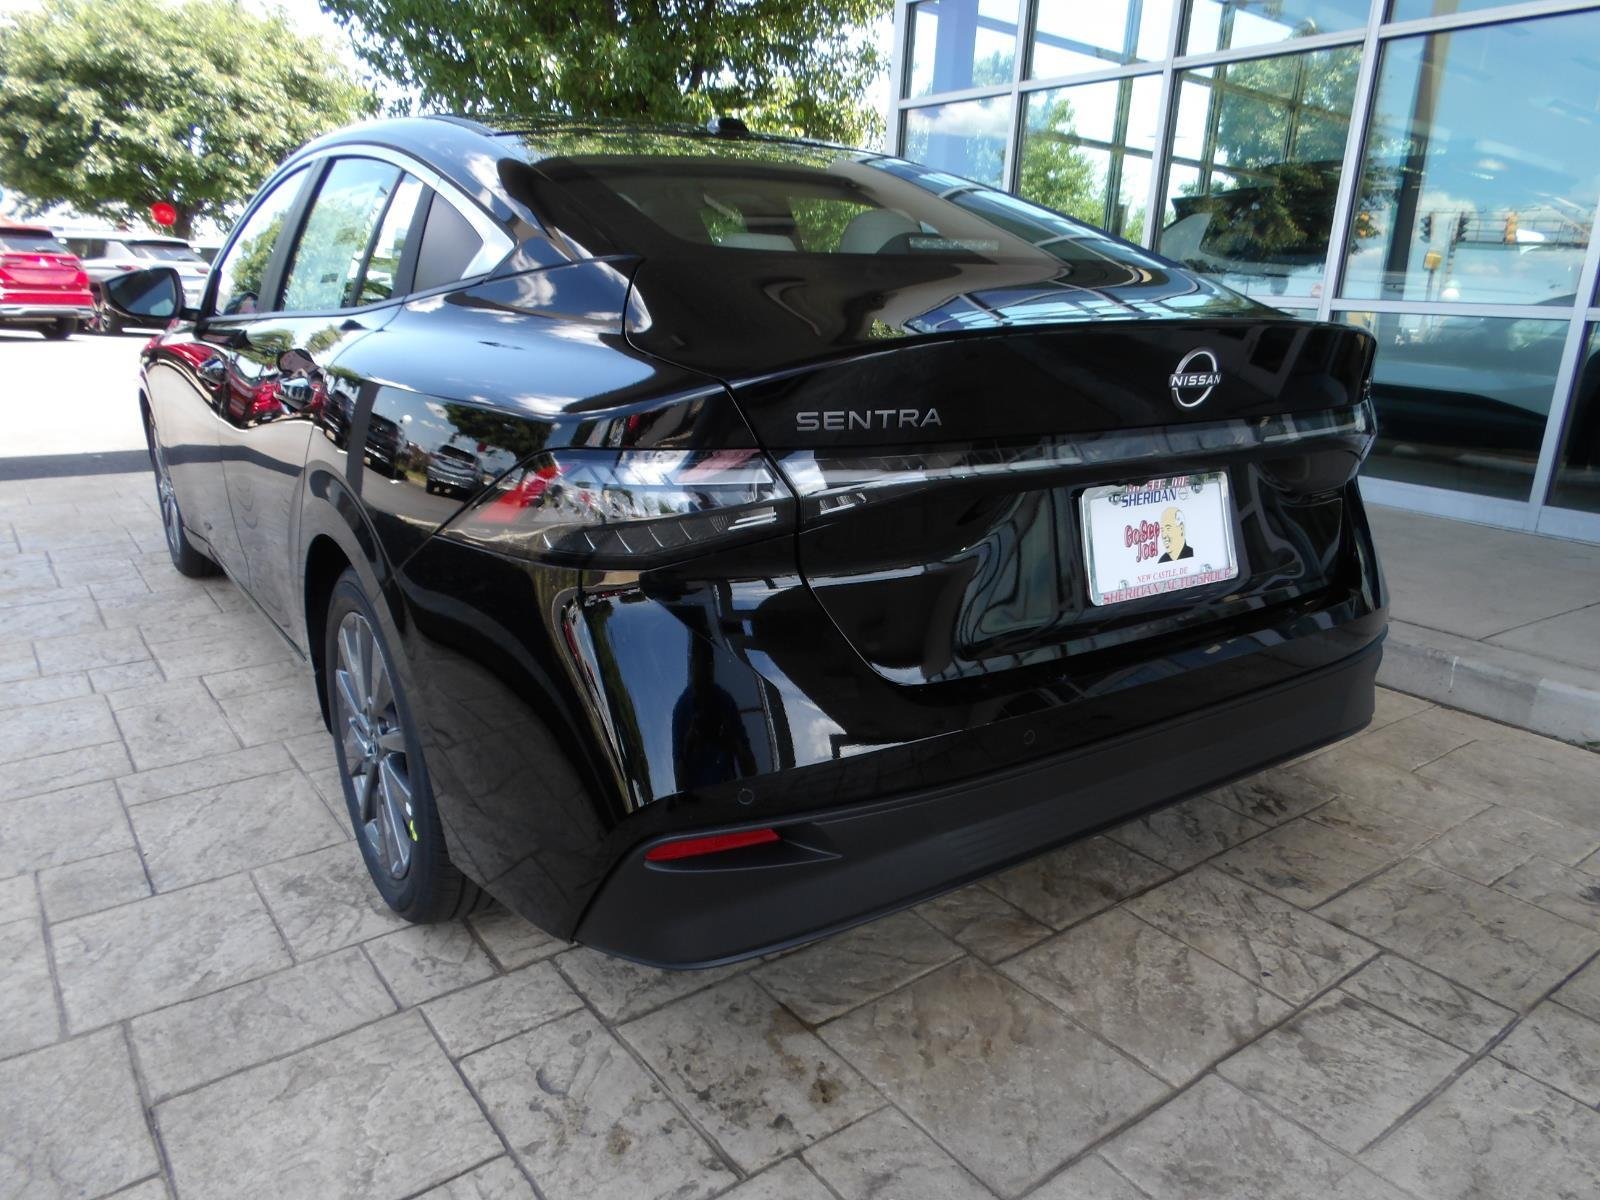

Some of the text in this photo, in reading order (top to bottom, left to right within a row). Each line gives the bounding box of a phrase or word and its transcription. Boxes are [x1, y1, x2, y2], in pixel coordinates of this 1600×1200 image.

[1171, 374, 1221, 387] NISSAN
[796, 408, 942, 431] SENTRA
[1121, 489, 1177, 508] SHERIDAN
[1136, 574, 1152, 584] NEW
[1179, 566, 1189, 575] DE
